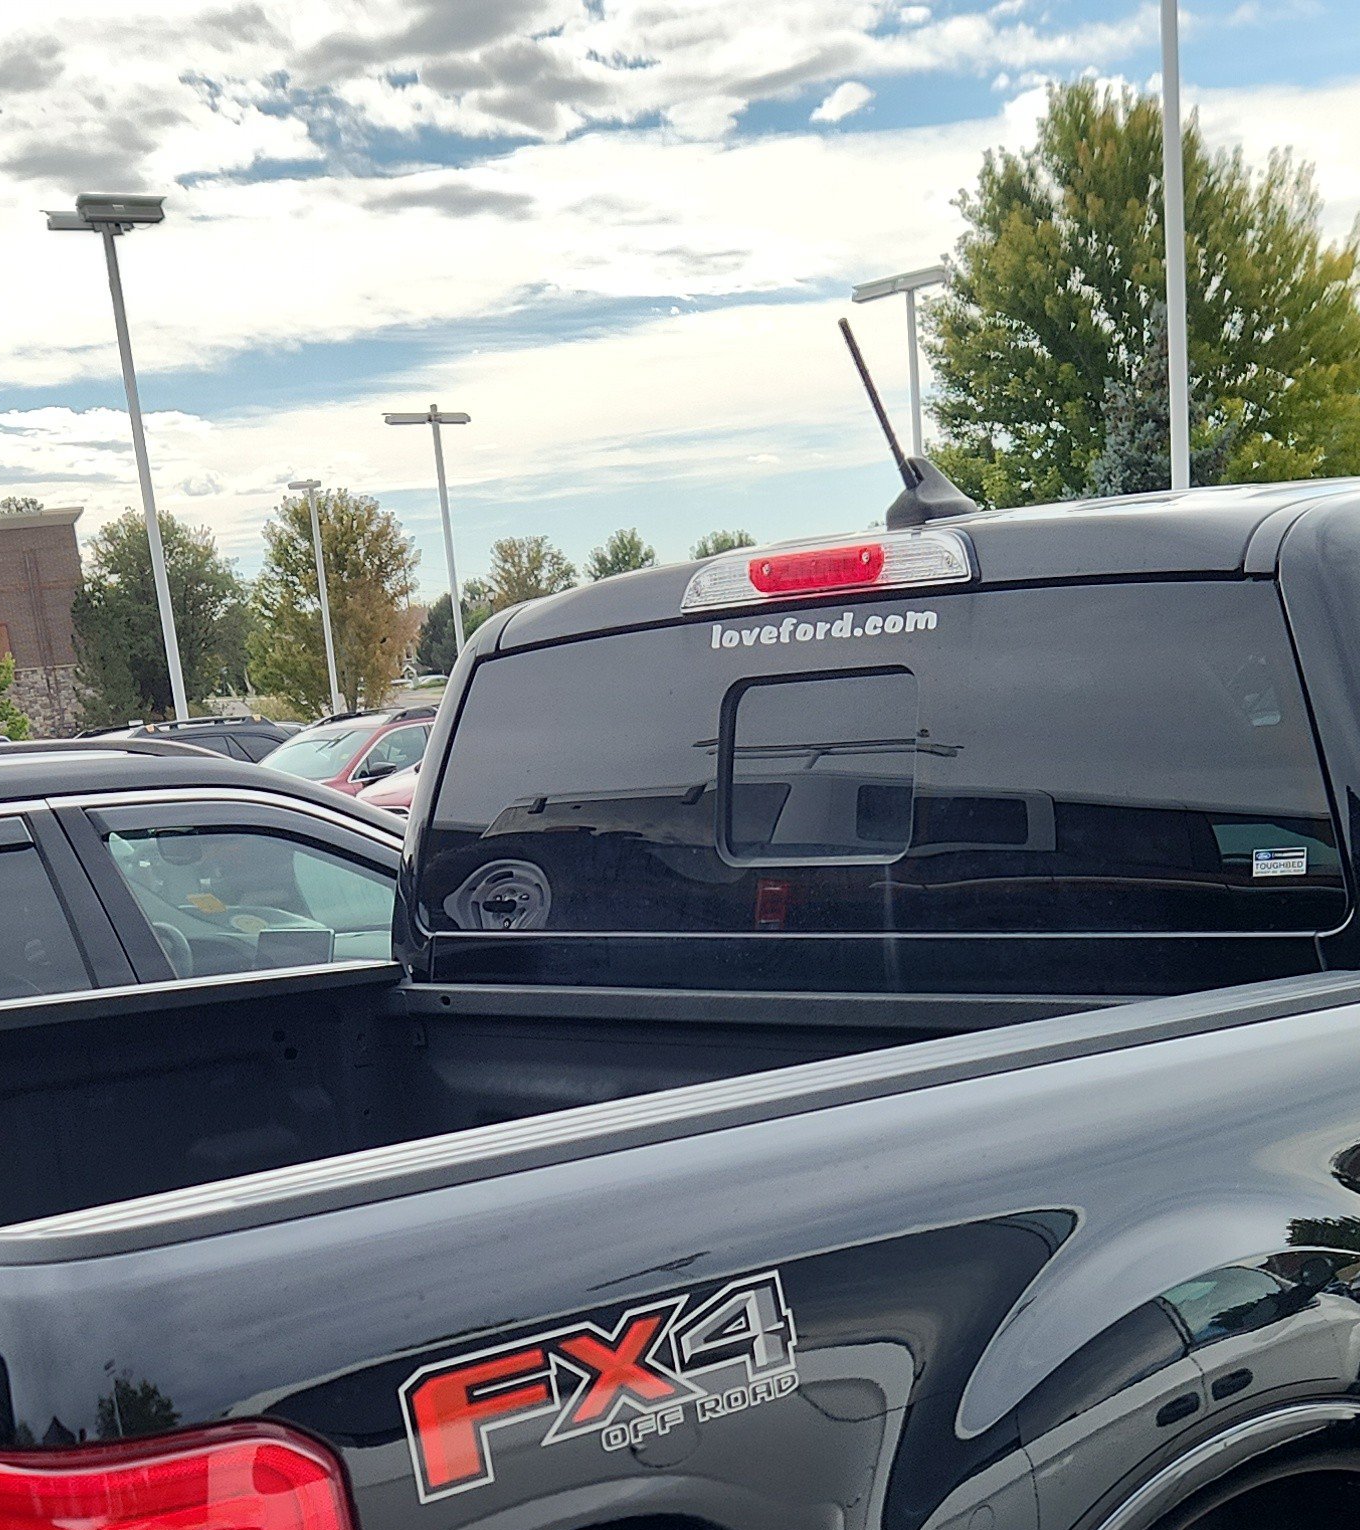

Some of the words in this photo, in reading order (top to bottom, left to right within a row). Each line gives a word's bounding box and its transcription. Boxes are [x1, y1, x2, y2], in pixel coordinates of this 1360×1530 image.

[711, 611, 938, 649] loveford.com
[1255, 861, 1304, 870] TOUGHBED
[398, 1269, 798, 1504] FX4
[601, 1404, 685, 1451] OFF
[697, 1370, 800, 1422] ROAD
